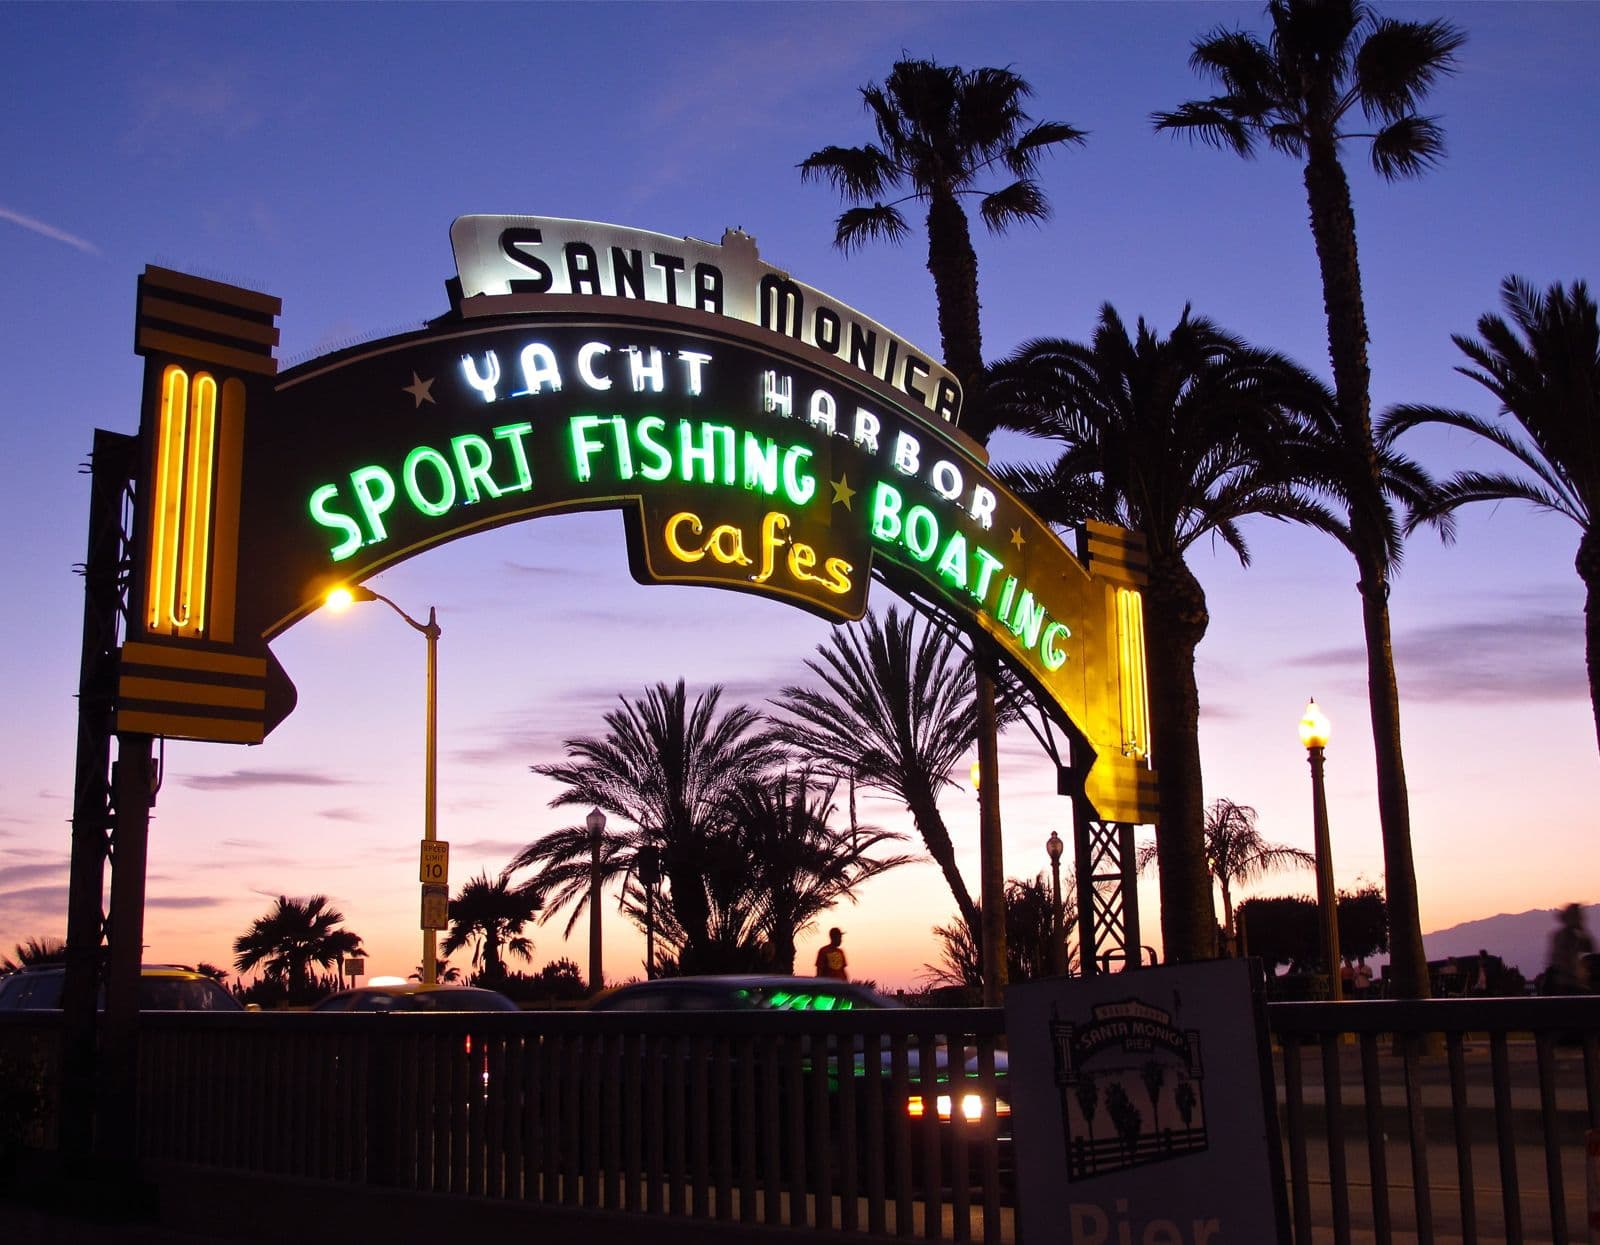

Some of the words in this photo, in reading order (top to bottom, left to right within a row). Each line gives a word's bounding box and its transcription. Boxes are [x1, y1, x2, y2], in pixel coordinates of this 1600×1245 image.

[500, 227, 724, 316] SANTA
[760, 274, 961, 427] MONICA
[461, 341, 713, 404] YACHT
[764, 368, 997, 529] HARBOR
[308, 421, 534, 562] SPORT
[569, 414, 816, 505] FISHING
[871, 480, 1072, 673] BOATING
[424, 845, 446, 853] SPEED
[426, 864, 443, 877] 10
[1081, 1022, 1129, 1049] SANTA
[1125, 1039, 1152, 1050] PIER
